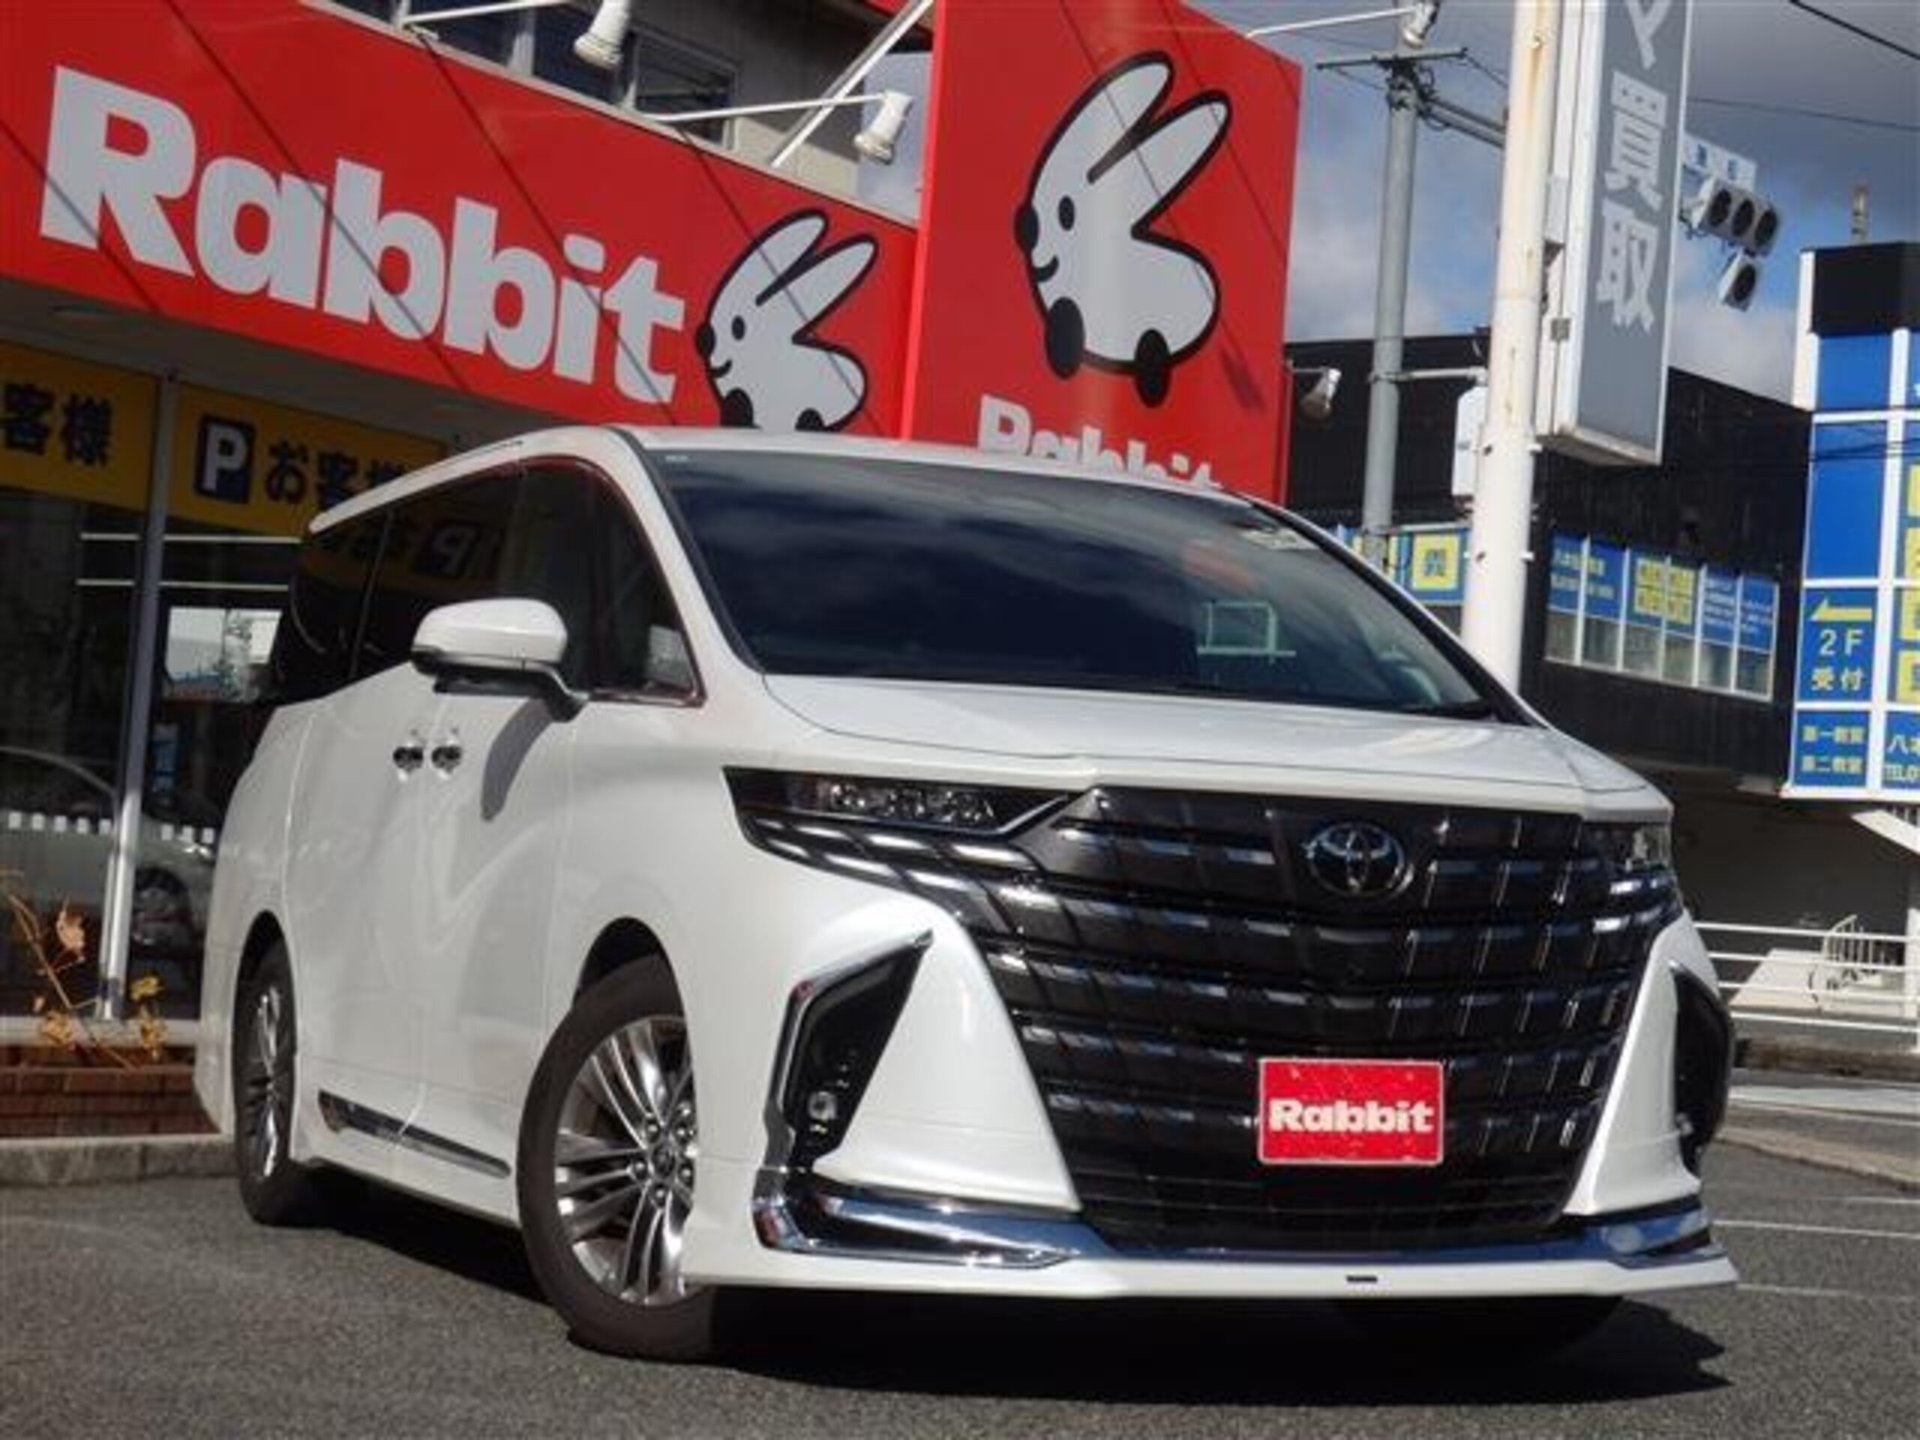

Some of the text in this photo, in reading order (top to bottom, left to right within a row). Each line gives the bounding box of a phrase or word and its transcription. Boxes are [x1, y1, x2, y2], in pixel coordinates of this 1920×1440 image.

[39, 66, 685, 405] Rabbit
[1819, 628, 1864, 656] 2F
[1269, 1098, 1434, 1133] Rabbit
